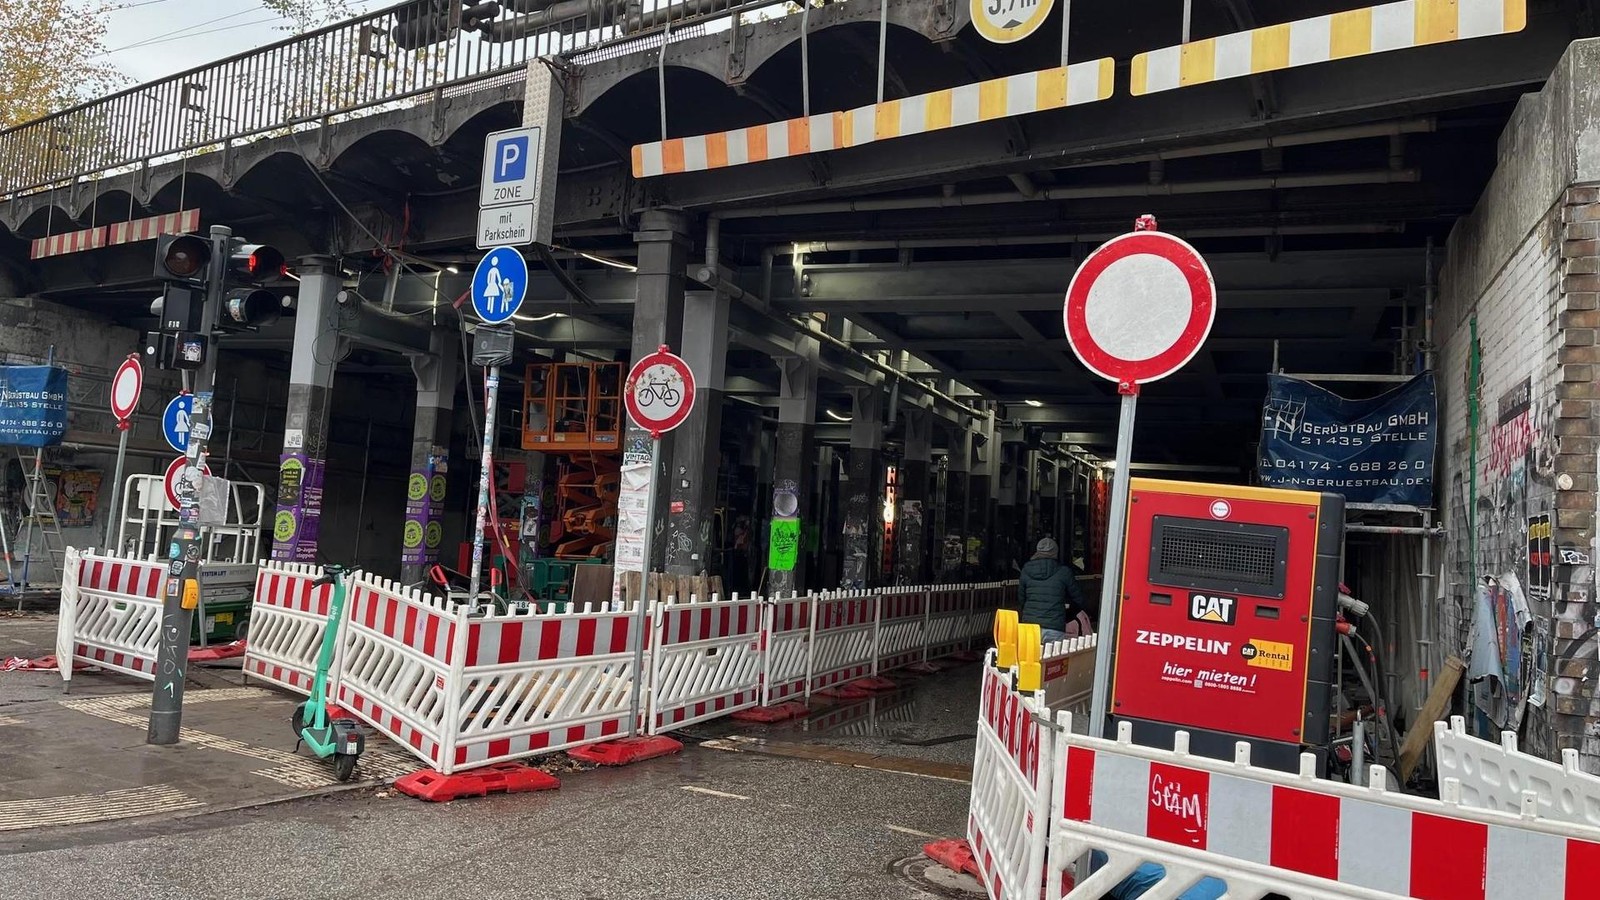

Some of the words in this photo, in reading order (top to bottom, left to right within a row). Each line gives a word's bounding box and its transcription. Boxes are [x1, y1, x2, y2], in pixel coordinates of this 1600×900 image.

[501, 144, 520, 177] P
[494, 186, 522, 200] ZONE
[499, 212, 512, 224] mit
[484, 226, 525, 241] Parkschein
[32, 401, 63, 410] STELLE
[1303, 421, 1382, 435] GERÜSTBAU
[1388, 411, 1428, 427] GMBH
[1301, 436, 1363, 446] 21435
[1371, 432, 1428, 443] STELLE
[1276, 459, 1330, 471] 04174
[1349, 461, 1381, 472] 688
[1388, 460, 1408, 470] 26
[1415, 460, 1425, 470] 0
[1192, 595, 1233, 622] CAT
[1136, 630, 1229, 655] ZEPPELIN
[1242, 647, 1255, 656] CAT
[1259, 650, 1290, 661] Rental
[1163, 662, 1192, 677] hier
[1197, 669, 1247, 686] mieten
